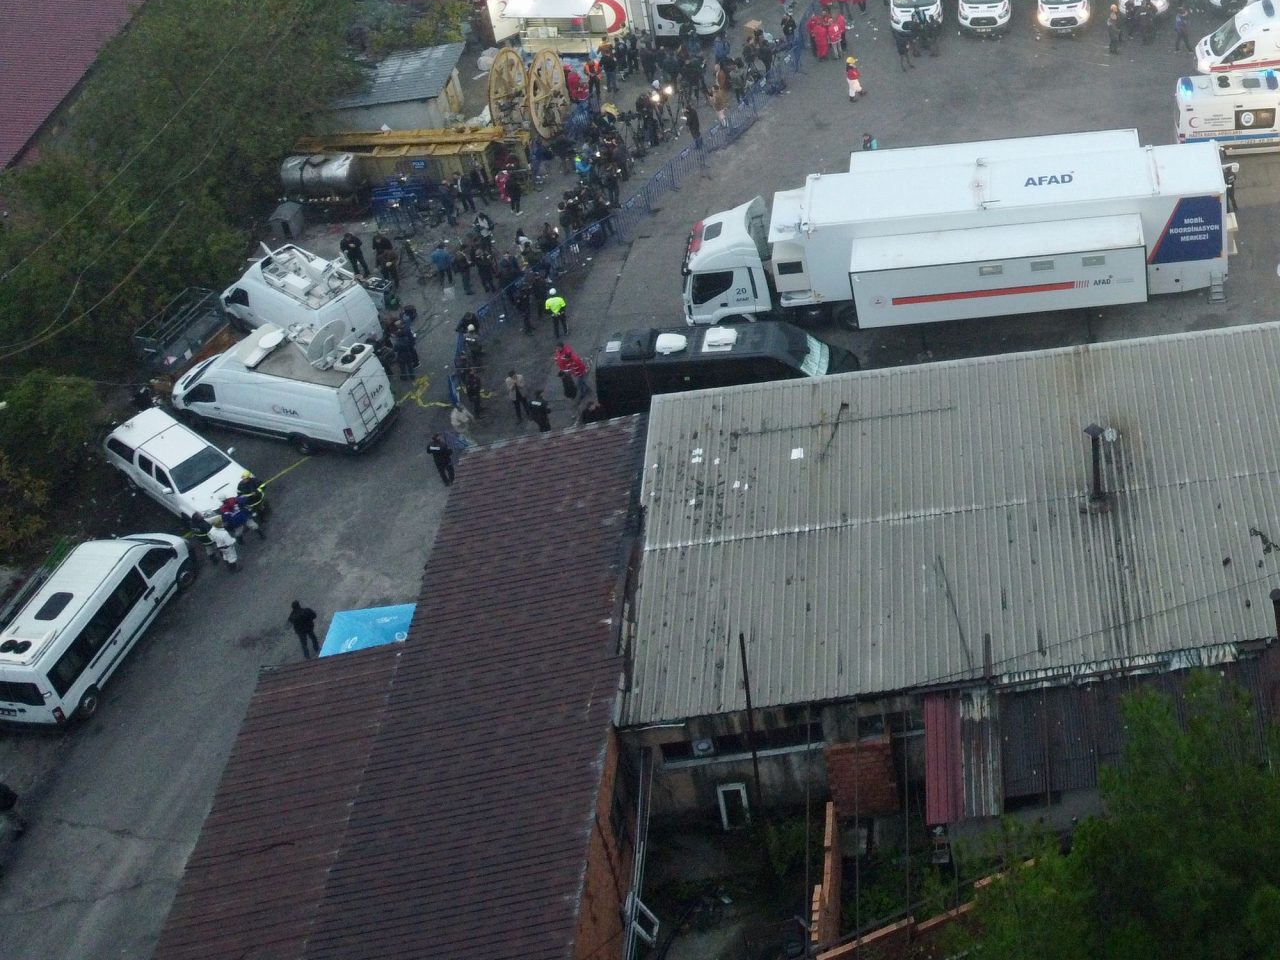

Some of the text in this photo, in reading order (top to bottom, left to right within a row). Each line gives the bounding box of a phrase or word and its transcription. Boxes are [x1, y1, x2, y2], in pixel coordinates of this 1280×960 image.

[1024, 173, 1074, 187] AFAD
[1183, 216, 1205, 225] MOBİL
[1169, 224, 1220, 235] KOORDİNASYON
[1180, 233, 1209, 242] MERKEZİ
[1093, 278, 1112, 287] AFAD
[735, 287, 747, 295] 20
